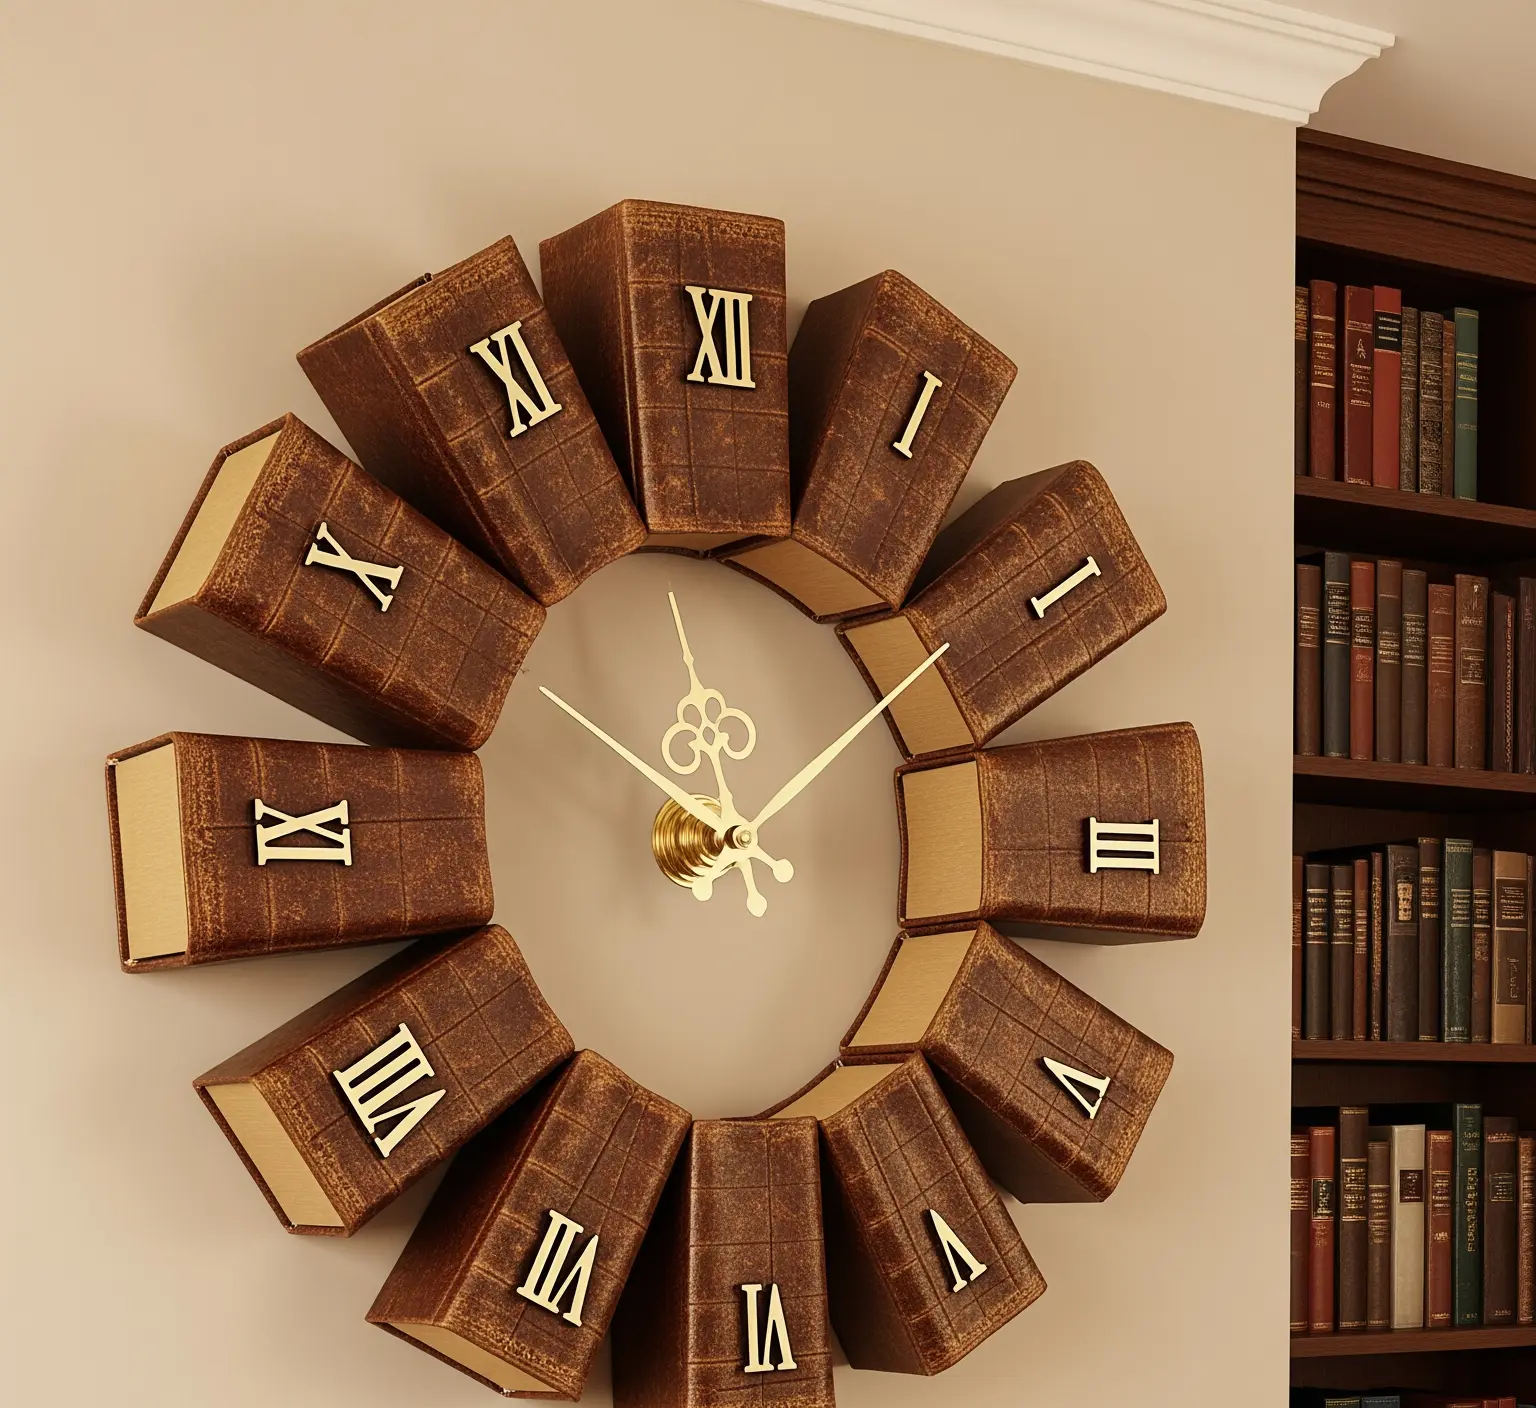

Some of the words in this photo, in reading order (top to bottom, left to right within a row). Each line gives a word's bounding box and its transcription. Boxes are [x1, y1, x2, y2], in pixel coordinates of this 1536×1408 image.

[469, 320, 562, 438] XI
[685, 285, 756, 389] XII
[893, 370, 943, 459] I
[304, 521, 404, 612] X
[1030, 556, 1102, 619] I
[254, 798, 352, 866] IX
[1089, 817, 1160, 875] III
[332, 1022, 446, 1158] VIII
[1043, 1056, 1111, 1120] V
[516, 1209, 599, 1327] VII
[929, 1209, 988, 1293] V
[741, 1283, 797, 1373] VI
